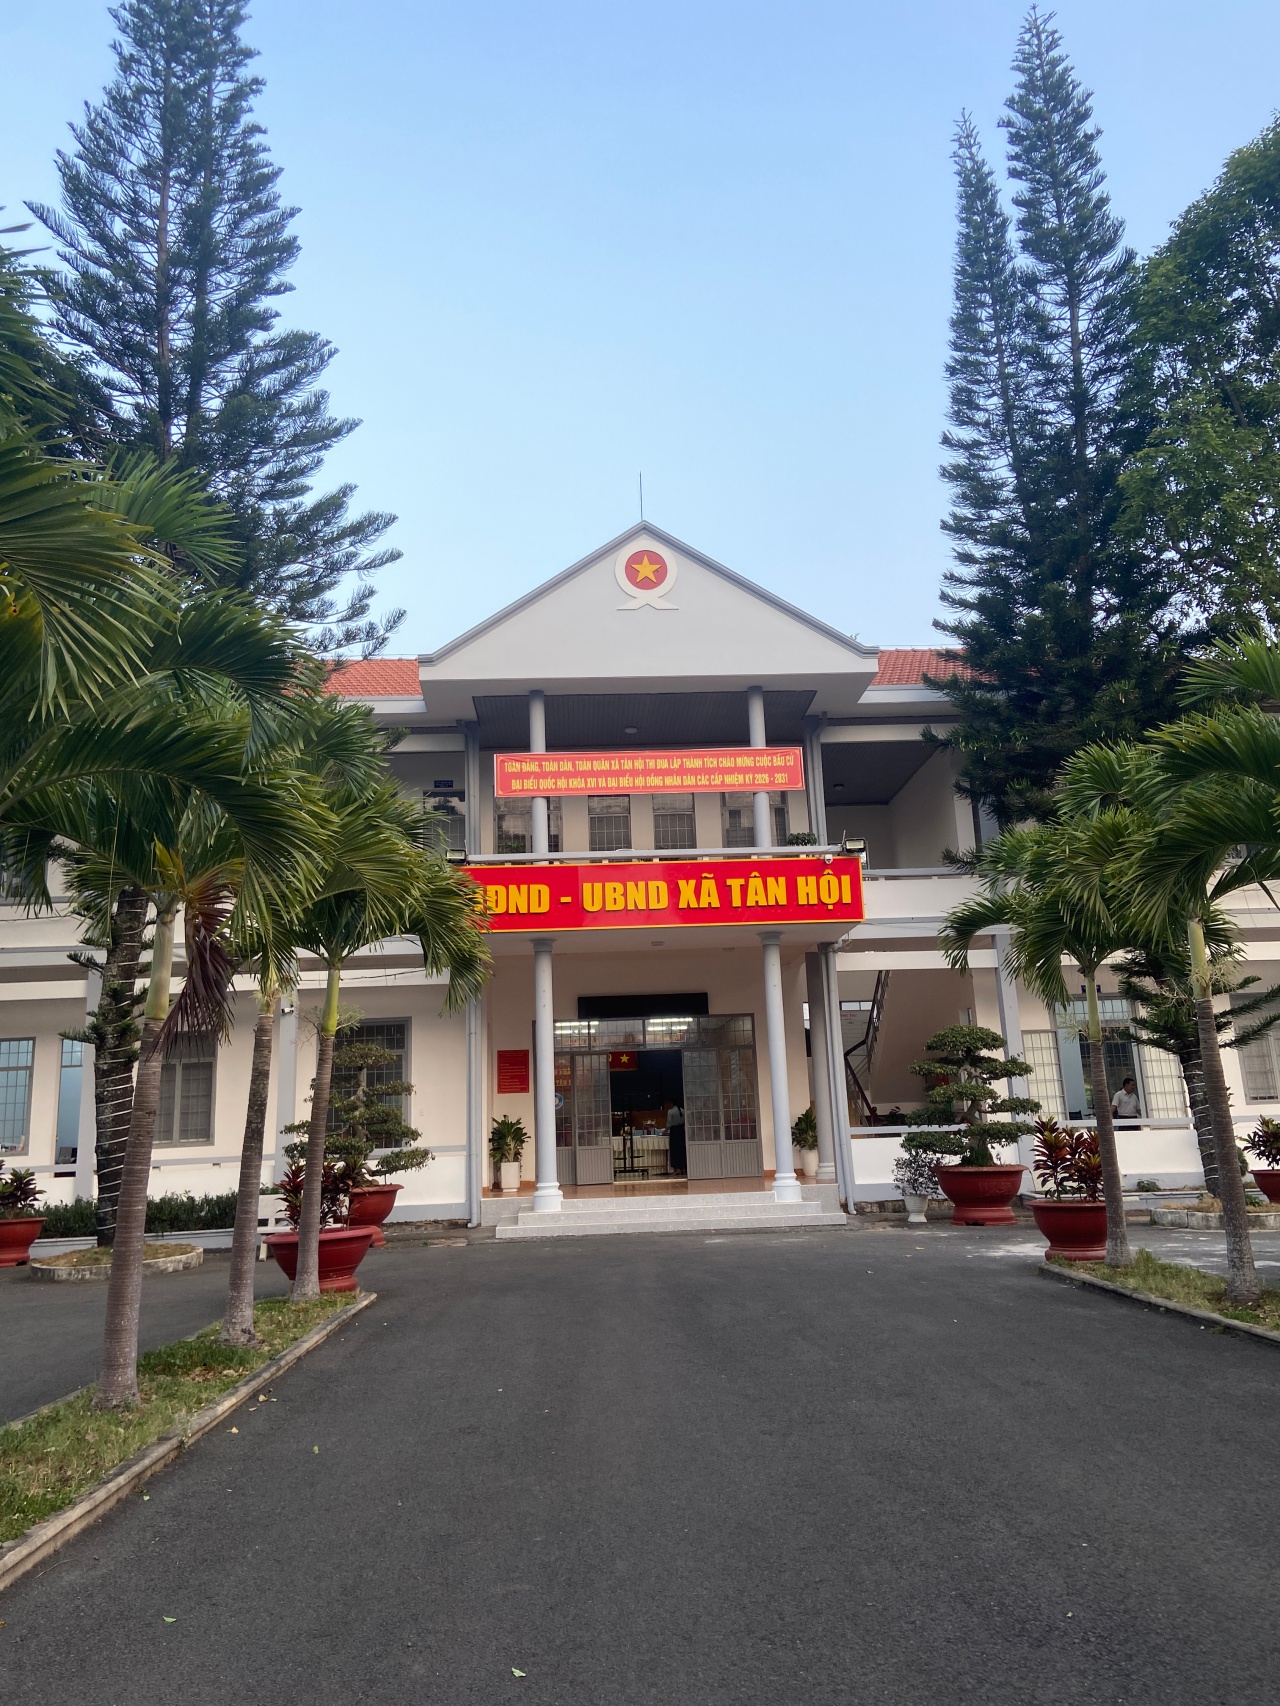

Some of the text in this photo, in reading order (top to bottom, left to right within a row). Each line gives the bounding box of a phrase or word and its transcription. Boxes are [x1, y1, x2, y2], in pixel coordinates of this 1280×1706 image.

[504, 760, 520, 773] TOÀN
[541, 759, 558, 772] TOÀN
[559, 758, 574, 772] DÂN,
[576, 758, 592, 772] TOÀN
[592, 758, 609, 772] QUÂN
[611, 757, 620, 770] XÃ
[621, 757, 632, 770] TÂN
[634, 756, 644, 772] HỘI
[645, 758, 655, 769] THI
[656, 758, 669, 769] ĐUA
[670, 756, 681, 771] LẬP
[683, 755, 702, 769] THÀNH
[703, 755, 718, 768] TÍCH
[719, 755, 735, 768] CHÀO
[755, 753, 772, 769] CUỘC
[511, 779, 523, 792] ĐẠI
[523, 774, 538, 790] BIỂU
[539, 775, 555, 790] QUỐC
[556, 776, 567, 791] HỘI
[568, 776, 585, 789] KHÓA
[586, 777, 597, 788] XVI
[597, 775, 607, 788] VÀ
[607, 776, 618, 790] ĐẠI
[619, 772, 633, 787] BIỂU
[634, 774, 645, 789] HỘI
[664, 773, 681, 786] NHÂN
[683, 773, 696, 786] DÂN
[696, 773, 709, 786] CÁC
[710, 771, 723, 786] CẤP
[724, 772, 744, 787] NHIỆM
[754, 773, 769, 784] 2026
[774, 773, 788, 784] 2031
[582, 880, 669, 912] UBND
[677, 872, 720, 909] XÃ
[726, 871, 787, 907] TÂN
[796, 868, 852, 910] HỘI
